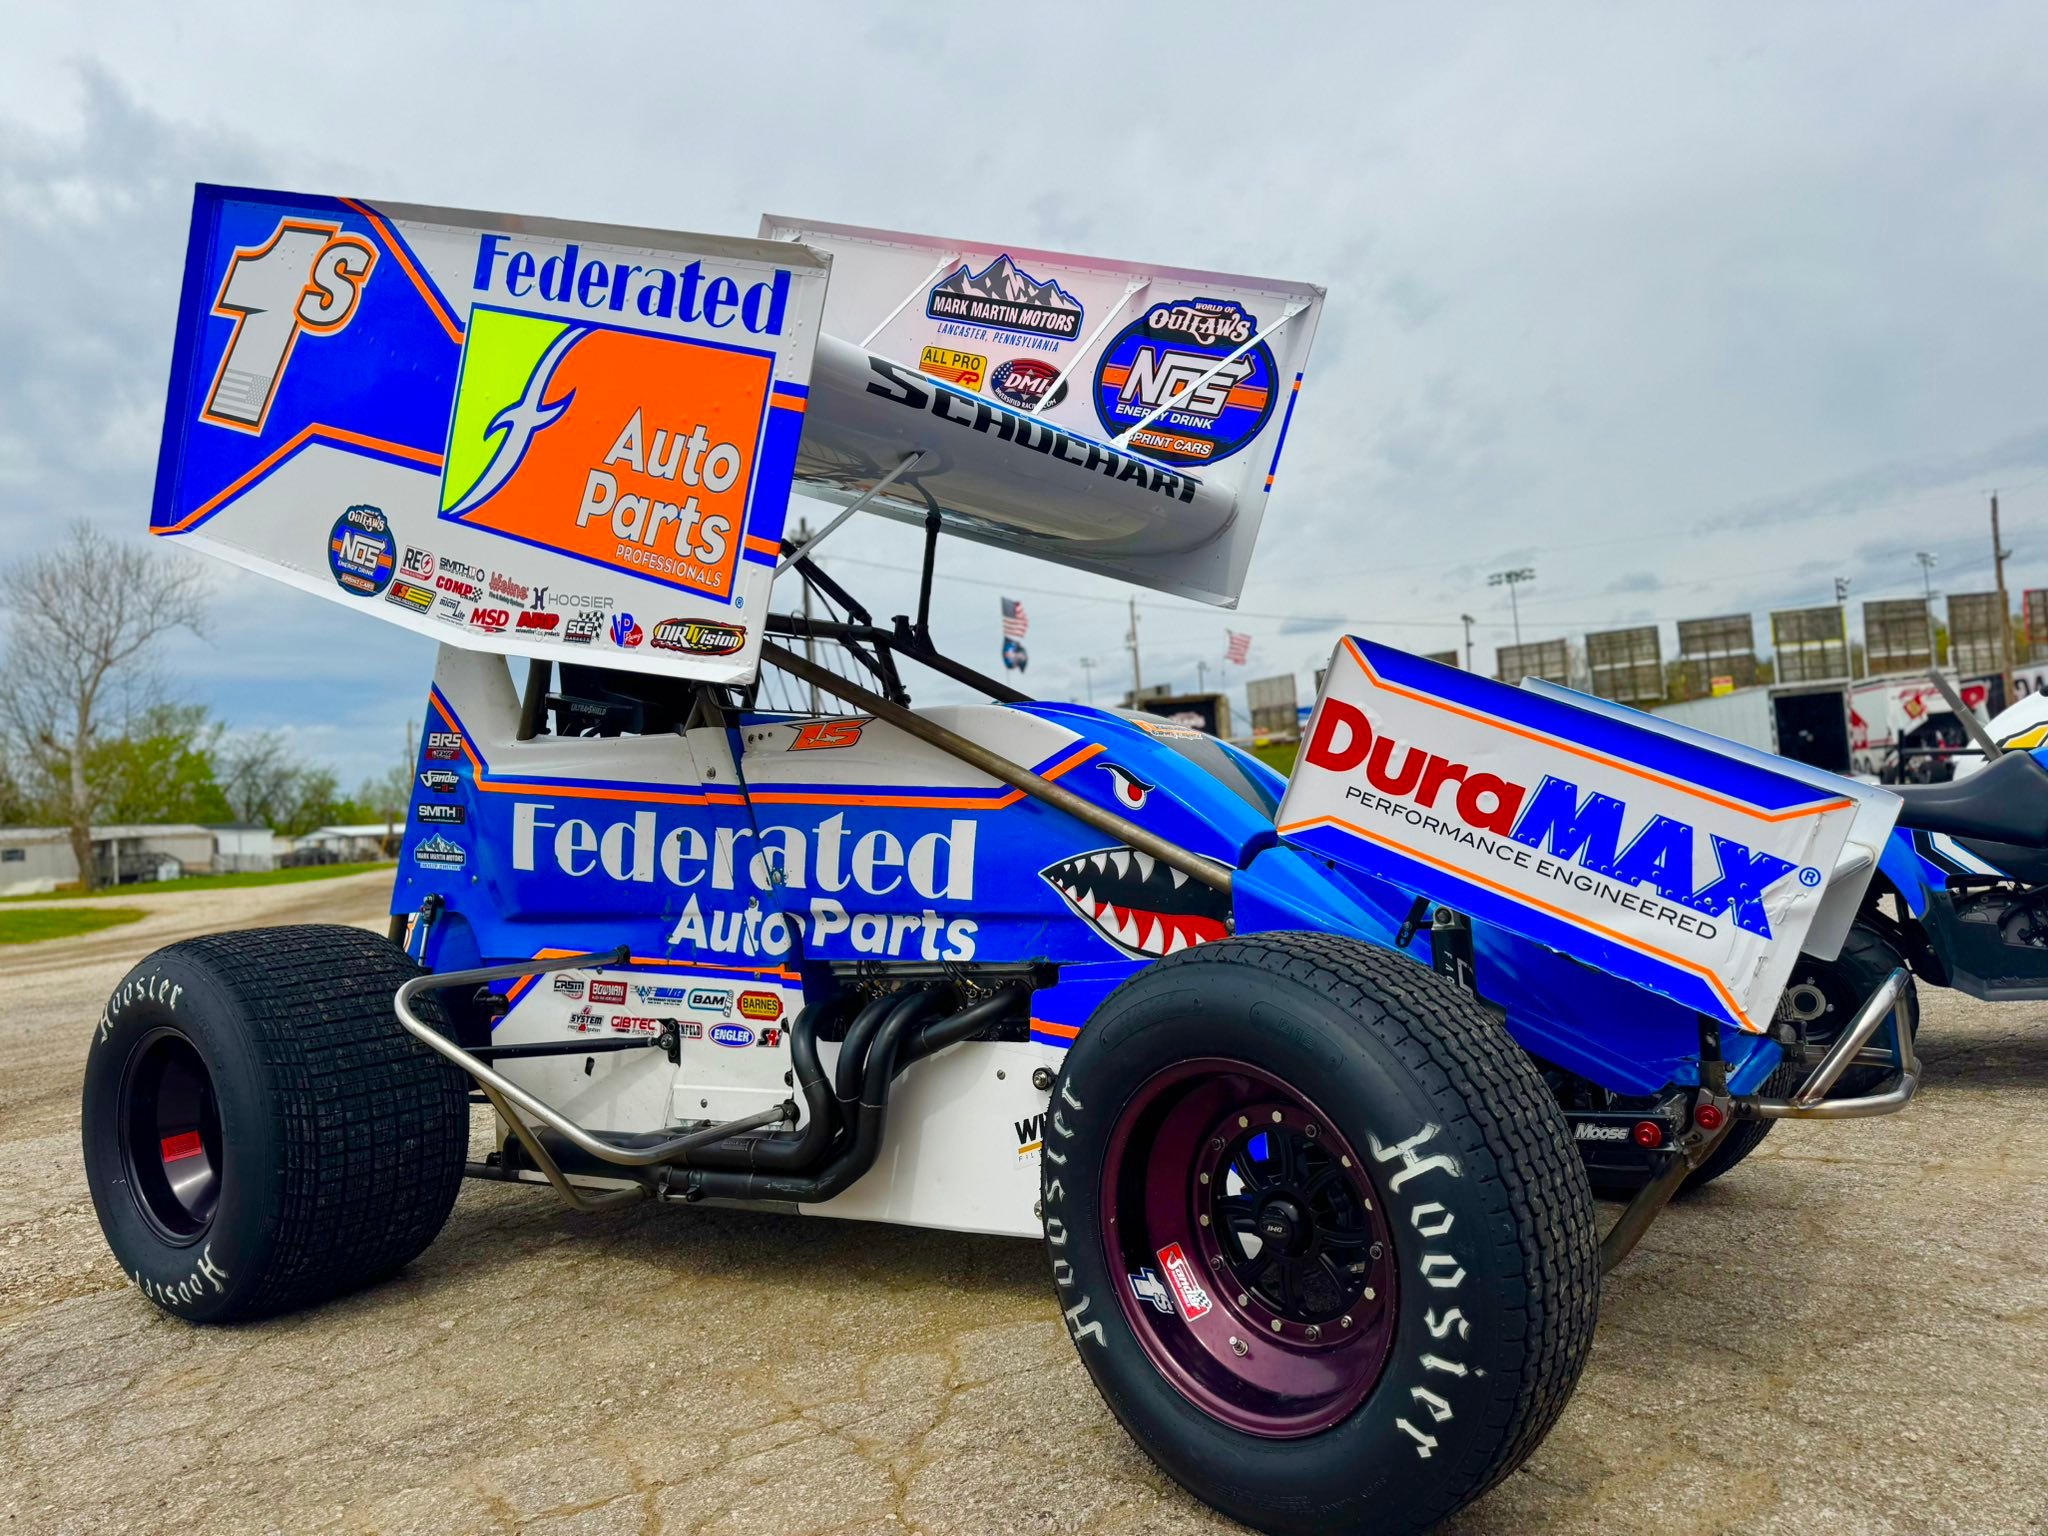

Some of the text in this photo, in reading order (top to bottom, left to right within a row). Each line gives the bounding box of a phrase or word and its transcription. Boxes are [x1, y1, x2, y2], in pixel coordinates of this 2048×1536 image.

[472, 233, 791, 336] Federated
[933, 296, 1075, 332] MARK MARTIN MOTORS
[1195, 303, 1236, 313] WORLD OF
[937, 323, 1060, 353] LANCASTER, PENNSYLVANIA
[924, 349, 980, 371] ALL PRO
[1004, 373, 1049, 394] DMI
[1119, 346, 1255, 417] NOS
[1116, 404, 1214, 429] ENERY DRINK
[603, 407, 742, 494] Auto
[1174, 439, 1211, 454] CARS
[576, 469, 732, 566] Parts
[340, 532, 386, 569] NOS
[615, 544, 723, 588] PROFESSIONALS
[435, 576, 473, 597] COMP
[549, 593, 613, 609] HOOSIER
[469, 608, 510, 626] MSD
[567, 621, 593, 635] SCE
[612, 612, 634, 648] VP
[428, 732, 461, 748] BRS
[512, 803, 977, 902] Federated
[1345, 786, 1718, 941] PERFORMANCE ENGINEERED
[671, 893, 978, 964] Auto Parts
[101, 967, 184, 1044] Hoosier
[693, 995, 725, 1006] BAM
[743, 998, 777, 1010] BARNES
[571, 1014, 602, 1025] SYSTEM
[611, 1015, 656, 1031] GIBTEC
[714, 1028, 750, 1042] ENGLER
[1014, 1112, 1047, 1145] WI
[1367, 1122, 1487, 1457] Hoosier
